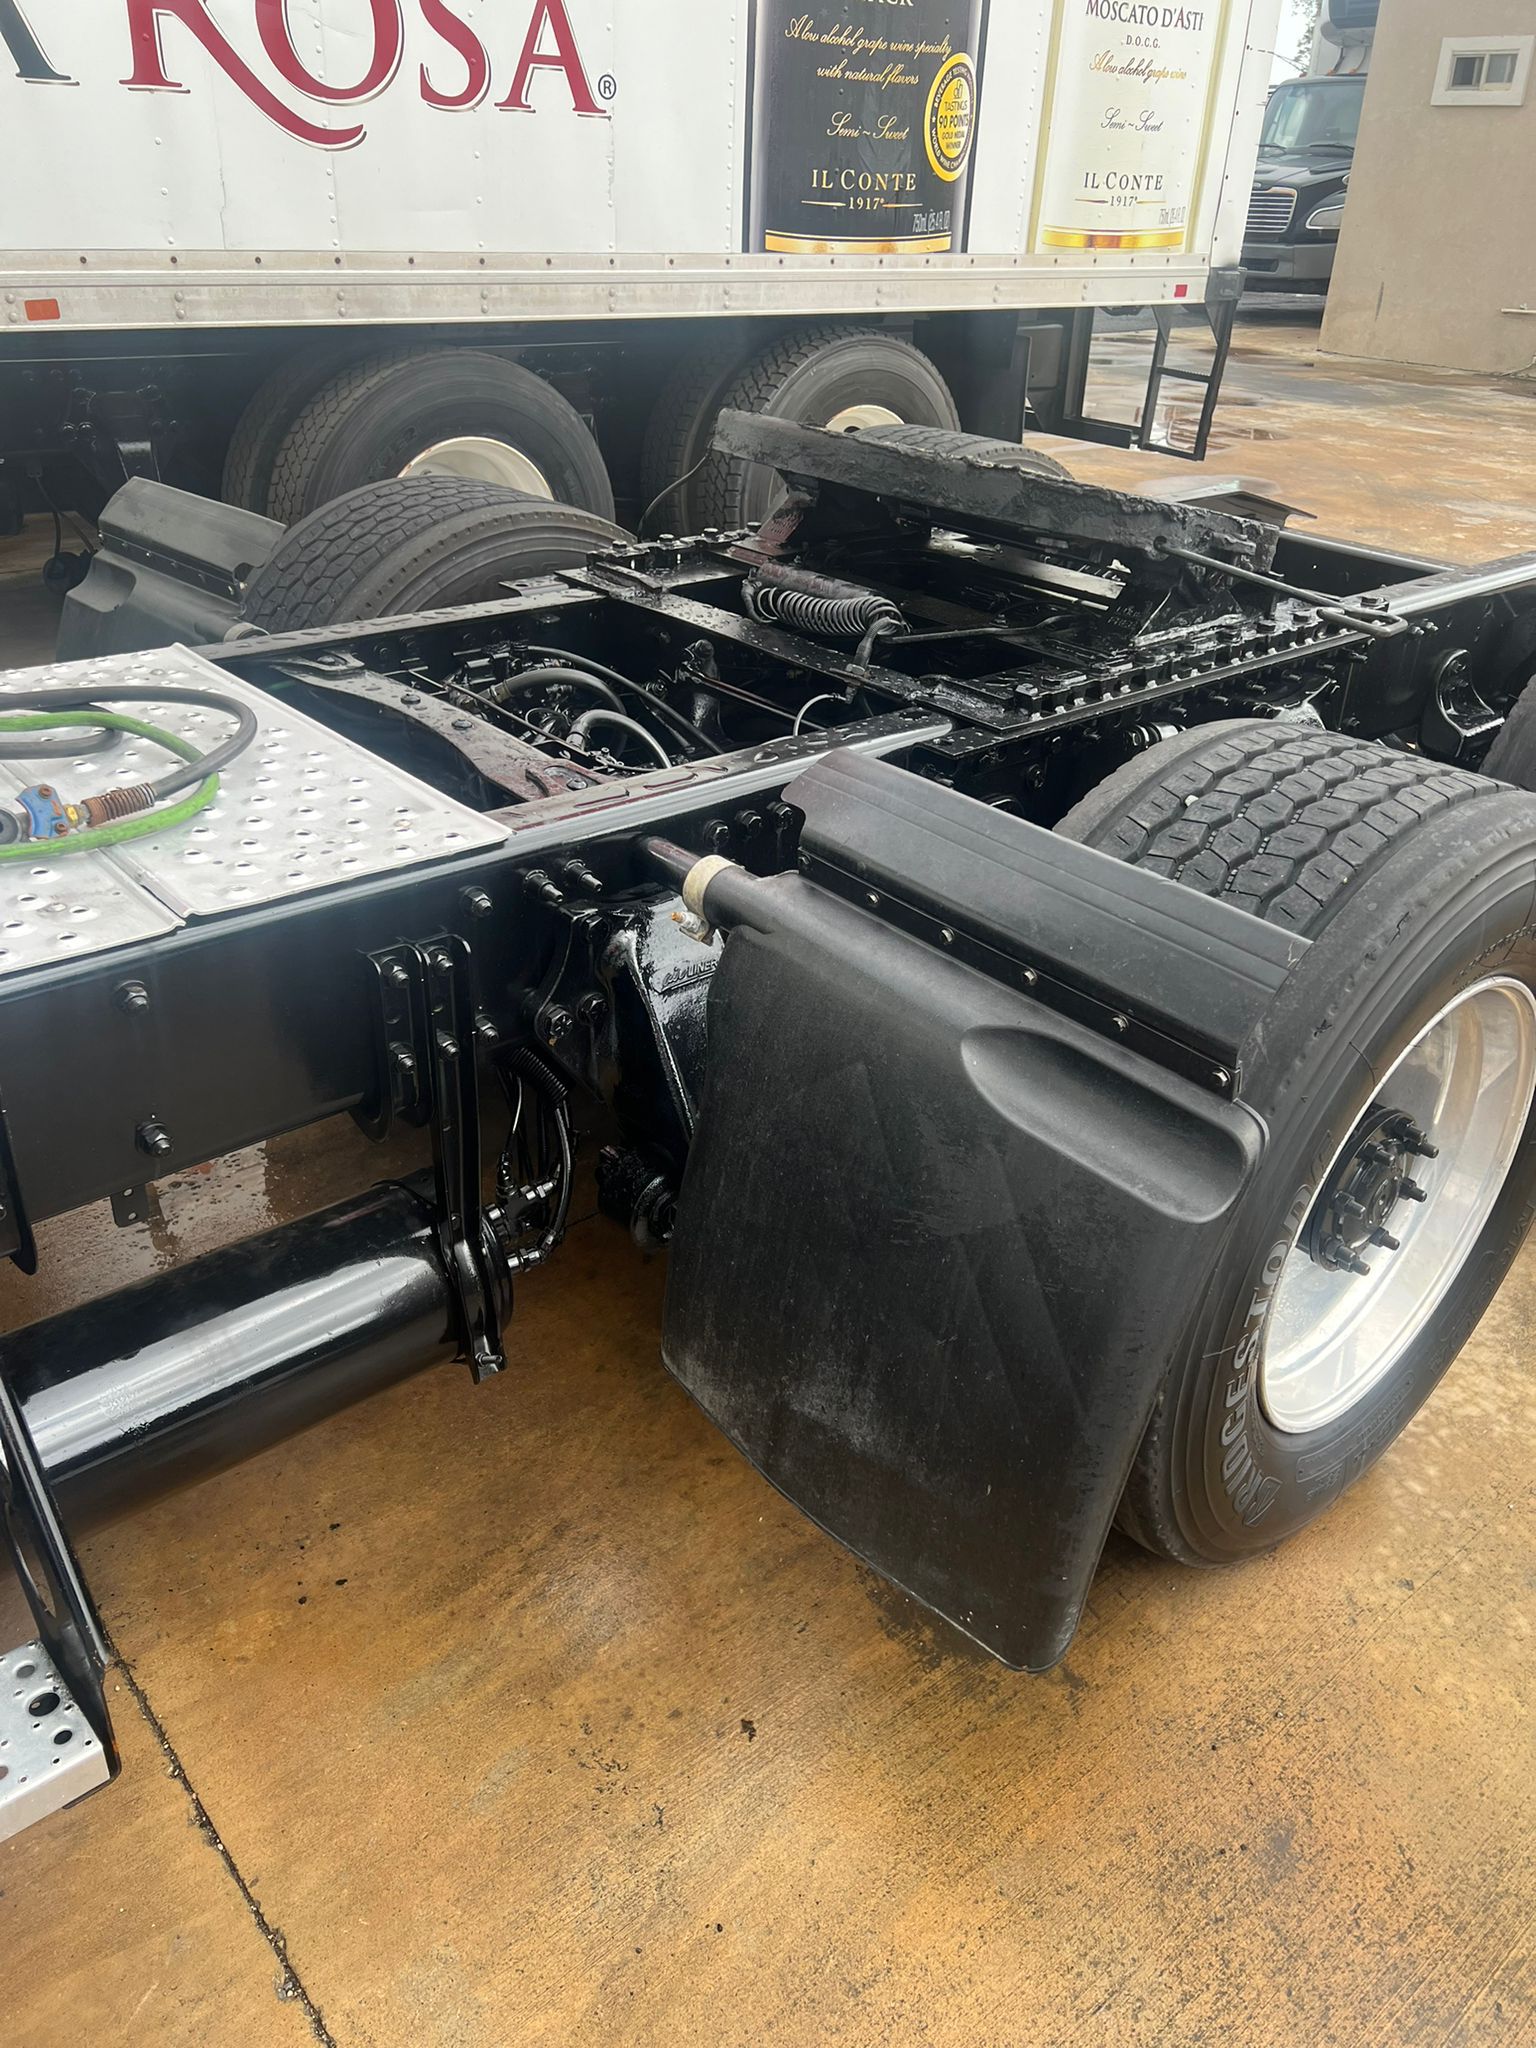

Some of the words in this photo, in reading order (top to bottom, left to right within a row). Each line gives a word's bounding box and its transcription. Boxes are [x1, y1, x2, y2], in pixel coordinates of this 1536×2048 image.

[1086, 0, 1159, 26] MOSCATO
[785, 15, 809, 38] A
[802, 20, 819, 42] low
[820, 24, 864, 47] alcohol
[852, 37, 888, 56] grape
[890, 40, 914, 51] wine
[914, 34, 952, 61] specialty
[1126, 35, 1161, 48] D.O.C.G.
[816, 59, 848, 78] with
[844, 63, 893, 82] natural
[882, 64, 919, 90] flavors
[1103, 54, 1118, 73] low
[1118, 57, 1154, 77] alcohol
[811, 169, 834, 189] IL
[840, 169, 917, 191] CONTE
[1084, 172, 1100, 189] IL
[1105, 171, 1164, 191] CONTE
